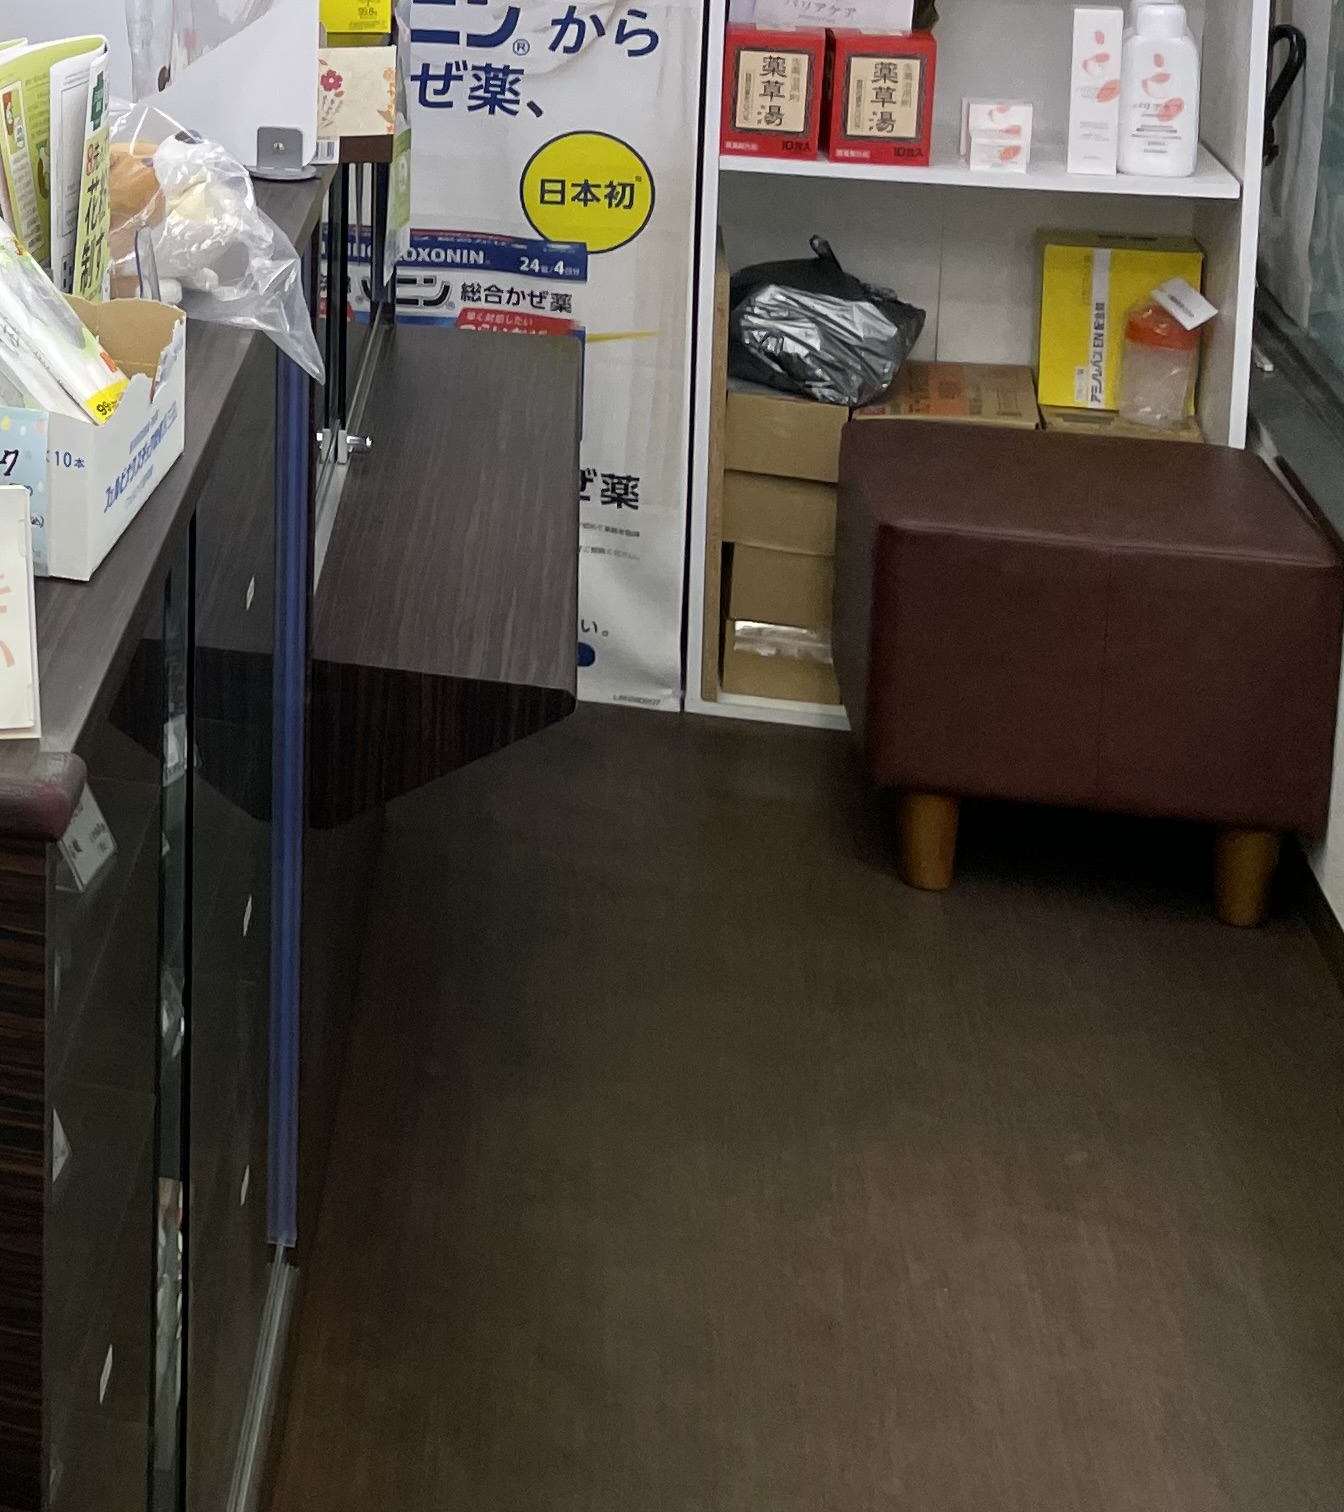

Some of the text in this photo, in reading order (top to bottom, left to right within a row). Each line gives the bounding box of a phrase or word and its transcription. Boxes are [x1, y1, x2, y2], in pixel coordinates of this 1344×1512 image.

[411, 60, 544, 117] ぜ薬、
[757, 54, 787, 127] 薬草湯
[868, 61, 899, 134] 薬草湯
[538, 178, 634, 209] 日本初
[460, 281, 572, 314] 総合かぜ薬
